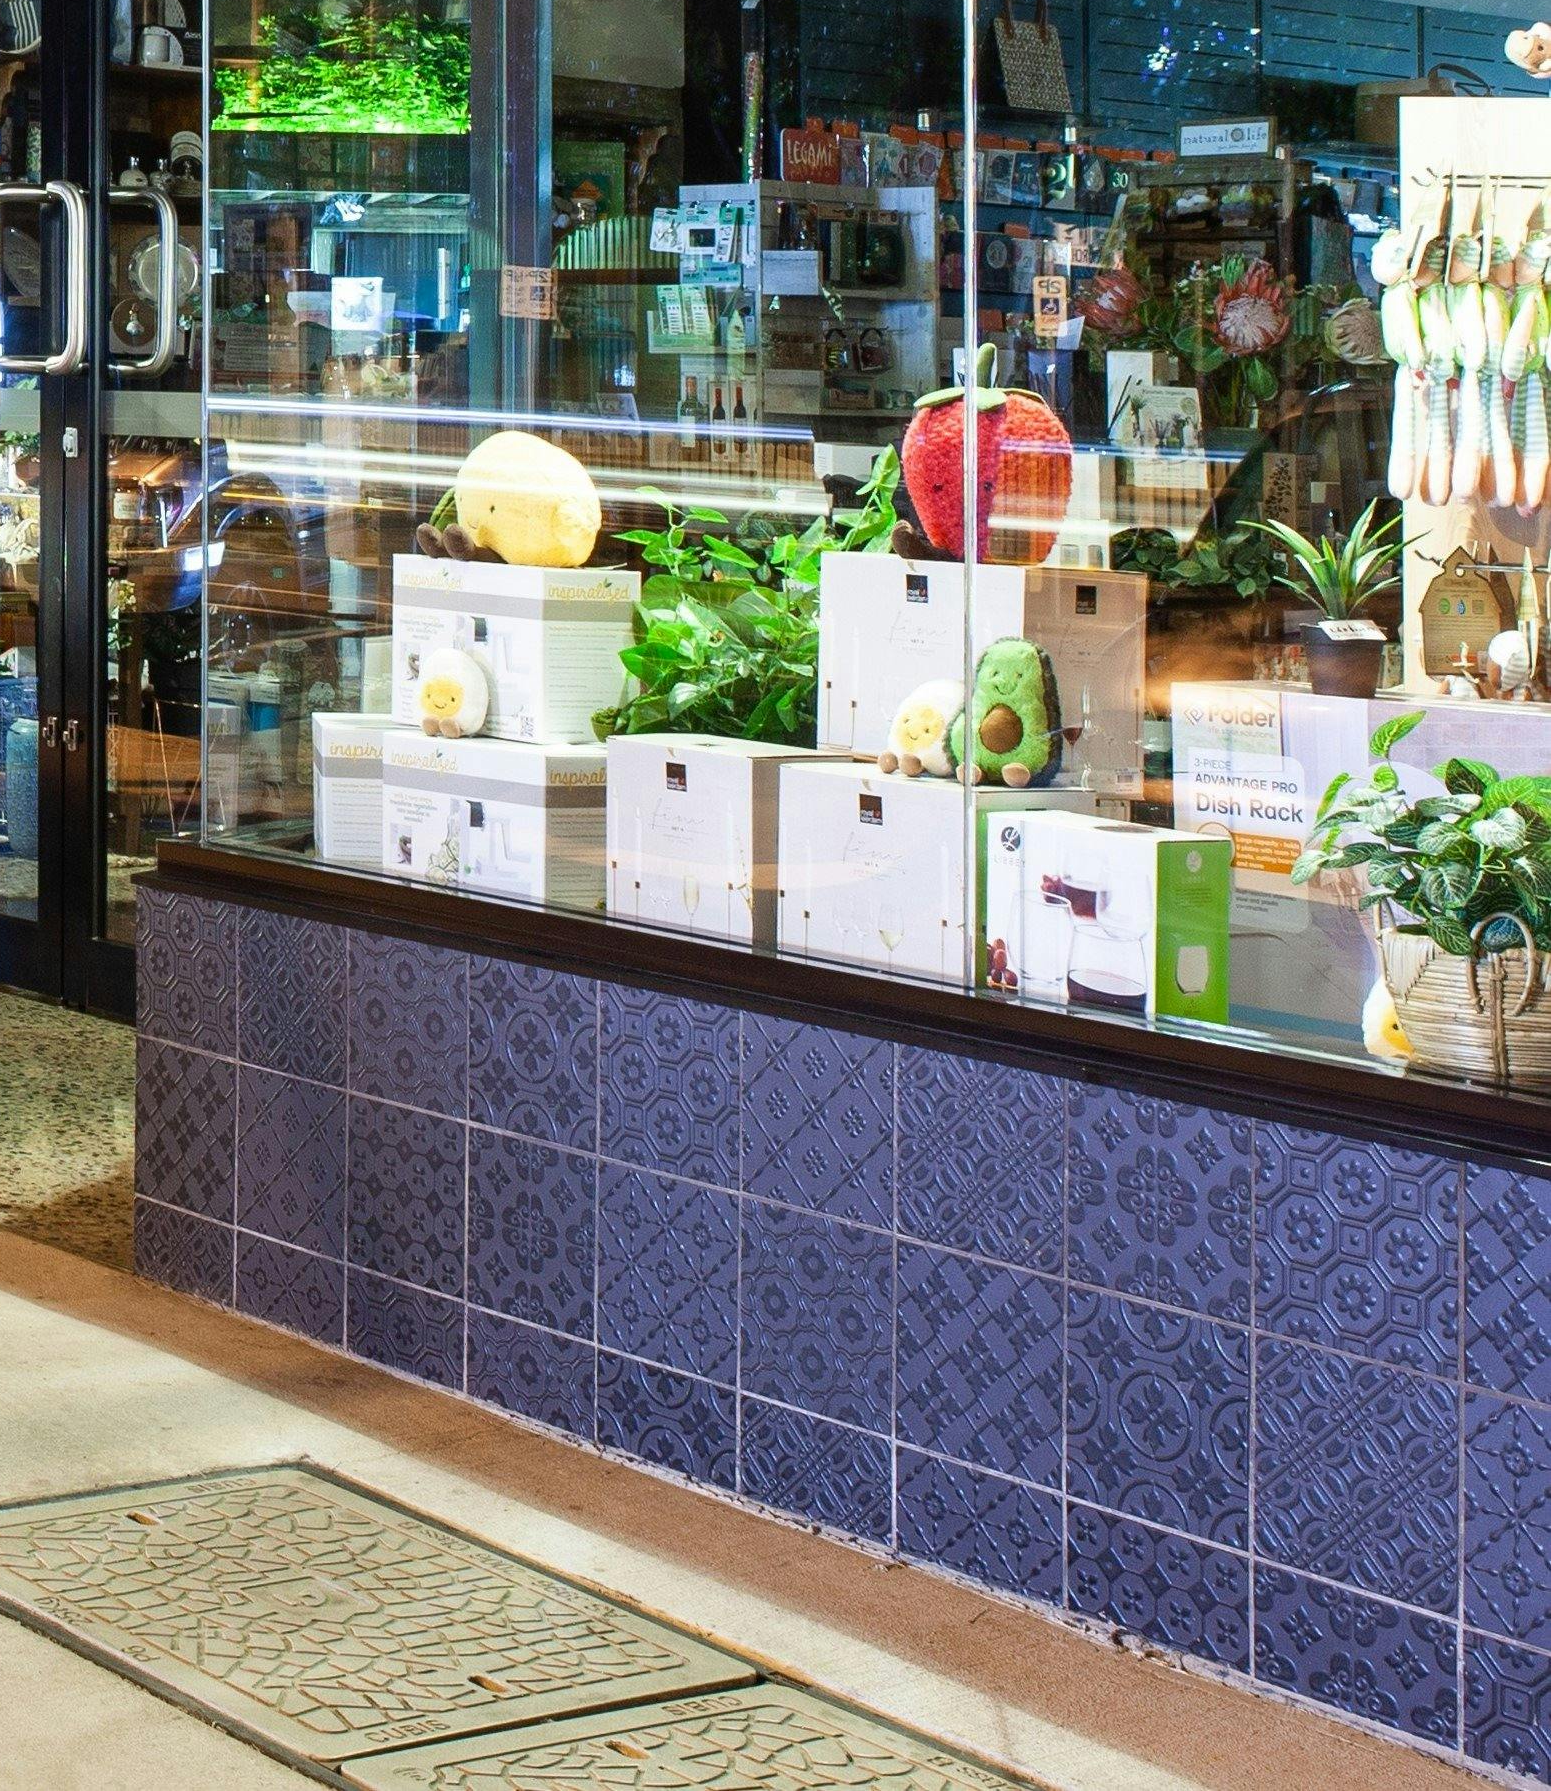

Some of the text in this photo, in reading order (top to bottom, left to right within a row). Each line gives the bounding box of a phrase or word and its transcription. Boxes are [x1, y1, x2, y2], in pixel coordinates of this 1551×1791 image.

[1194, 756, 1232, 771] 3-PIECE
[1195, 772, 1299, 795] ADVANTAGE PRO
[1197, 792, 1304, 824] Dish Rack
[660, 1695, 743, 1716] CUBIS
[363, 1717, 452, 1745] CUBIS
